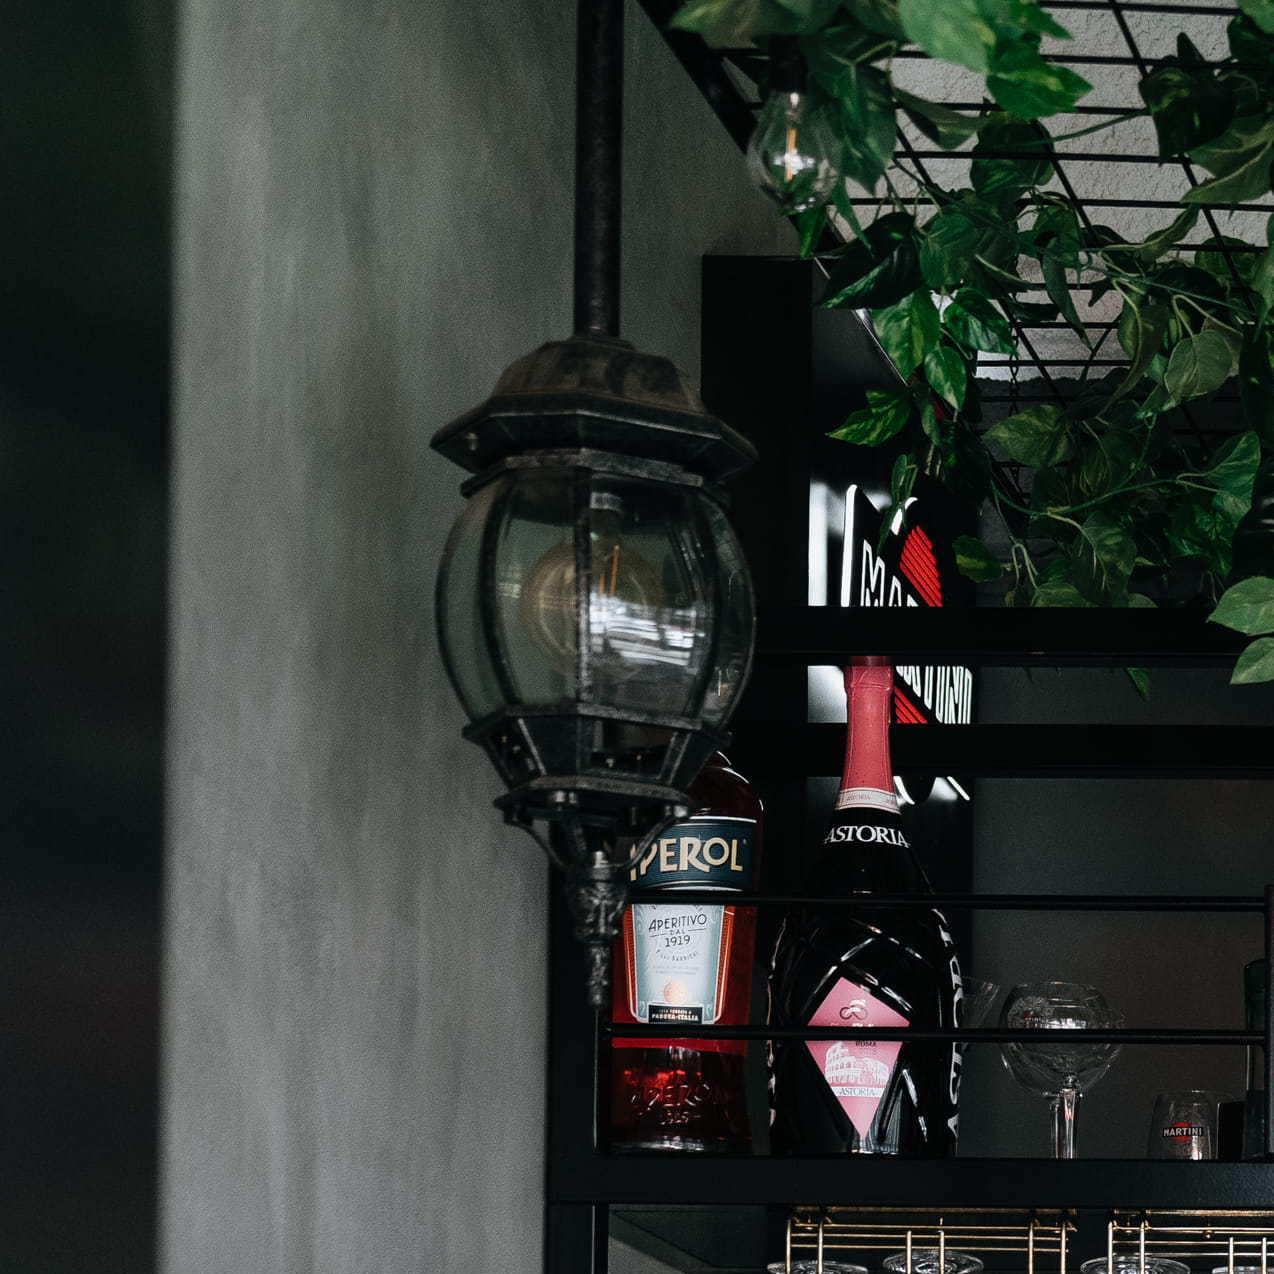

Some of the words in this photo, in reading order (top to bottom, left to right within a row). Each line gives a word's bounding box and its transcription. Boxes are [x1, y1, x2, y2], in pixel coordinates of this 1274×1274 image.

[824, 825, 911, 848] ASTORIA
[629, 836, 744, 882] PEROL
[649, 913, 708, 933] APERITIVO
[664, 934, 691, 948] 1919
[840, 1087, 876, 1096] ASTORIA
[1163, 1126, 1203, 1138] MARTINI
